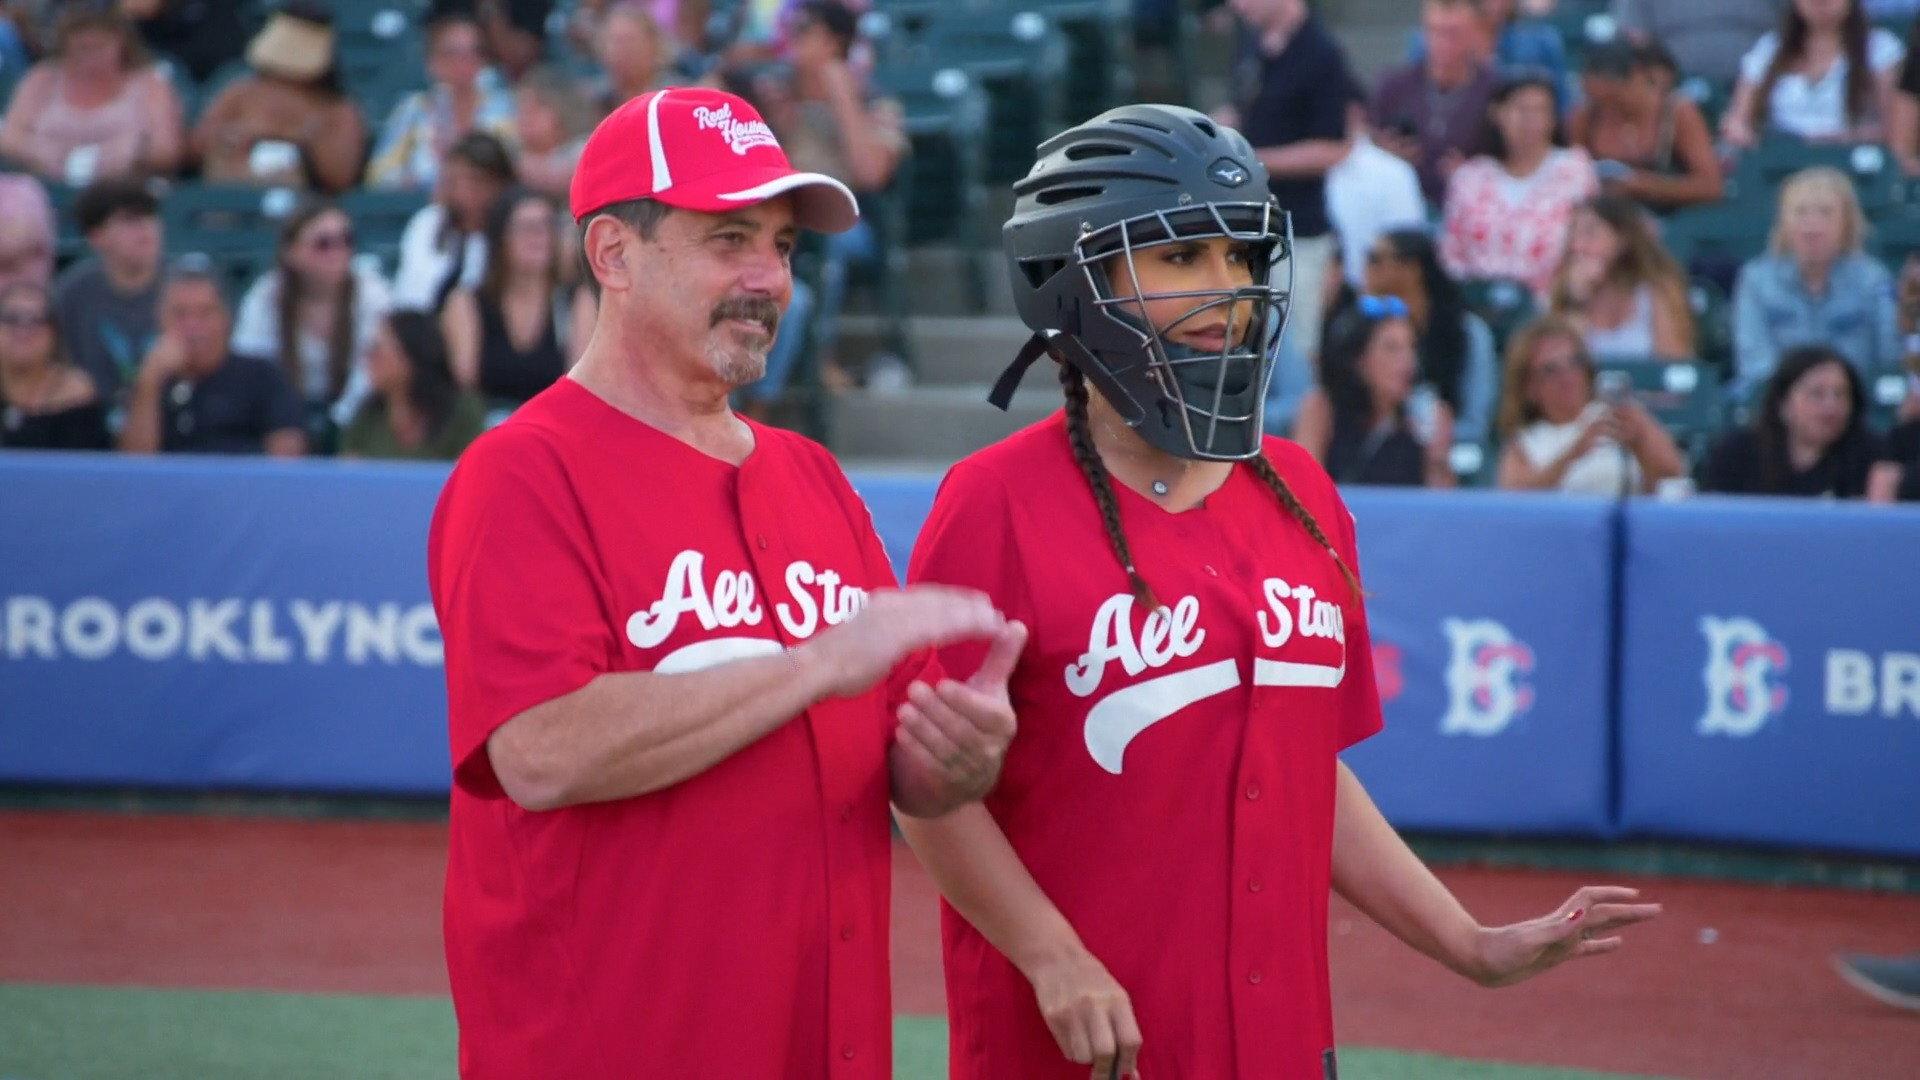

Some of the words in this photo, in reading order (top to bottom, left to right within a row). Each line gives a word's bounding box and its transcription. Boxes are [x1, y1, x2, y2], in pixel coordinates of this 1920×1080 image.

[693, 102, 732, 130] Real
[626, 549, 762, 648] All
[1064, 593, 1205, 697] All
